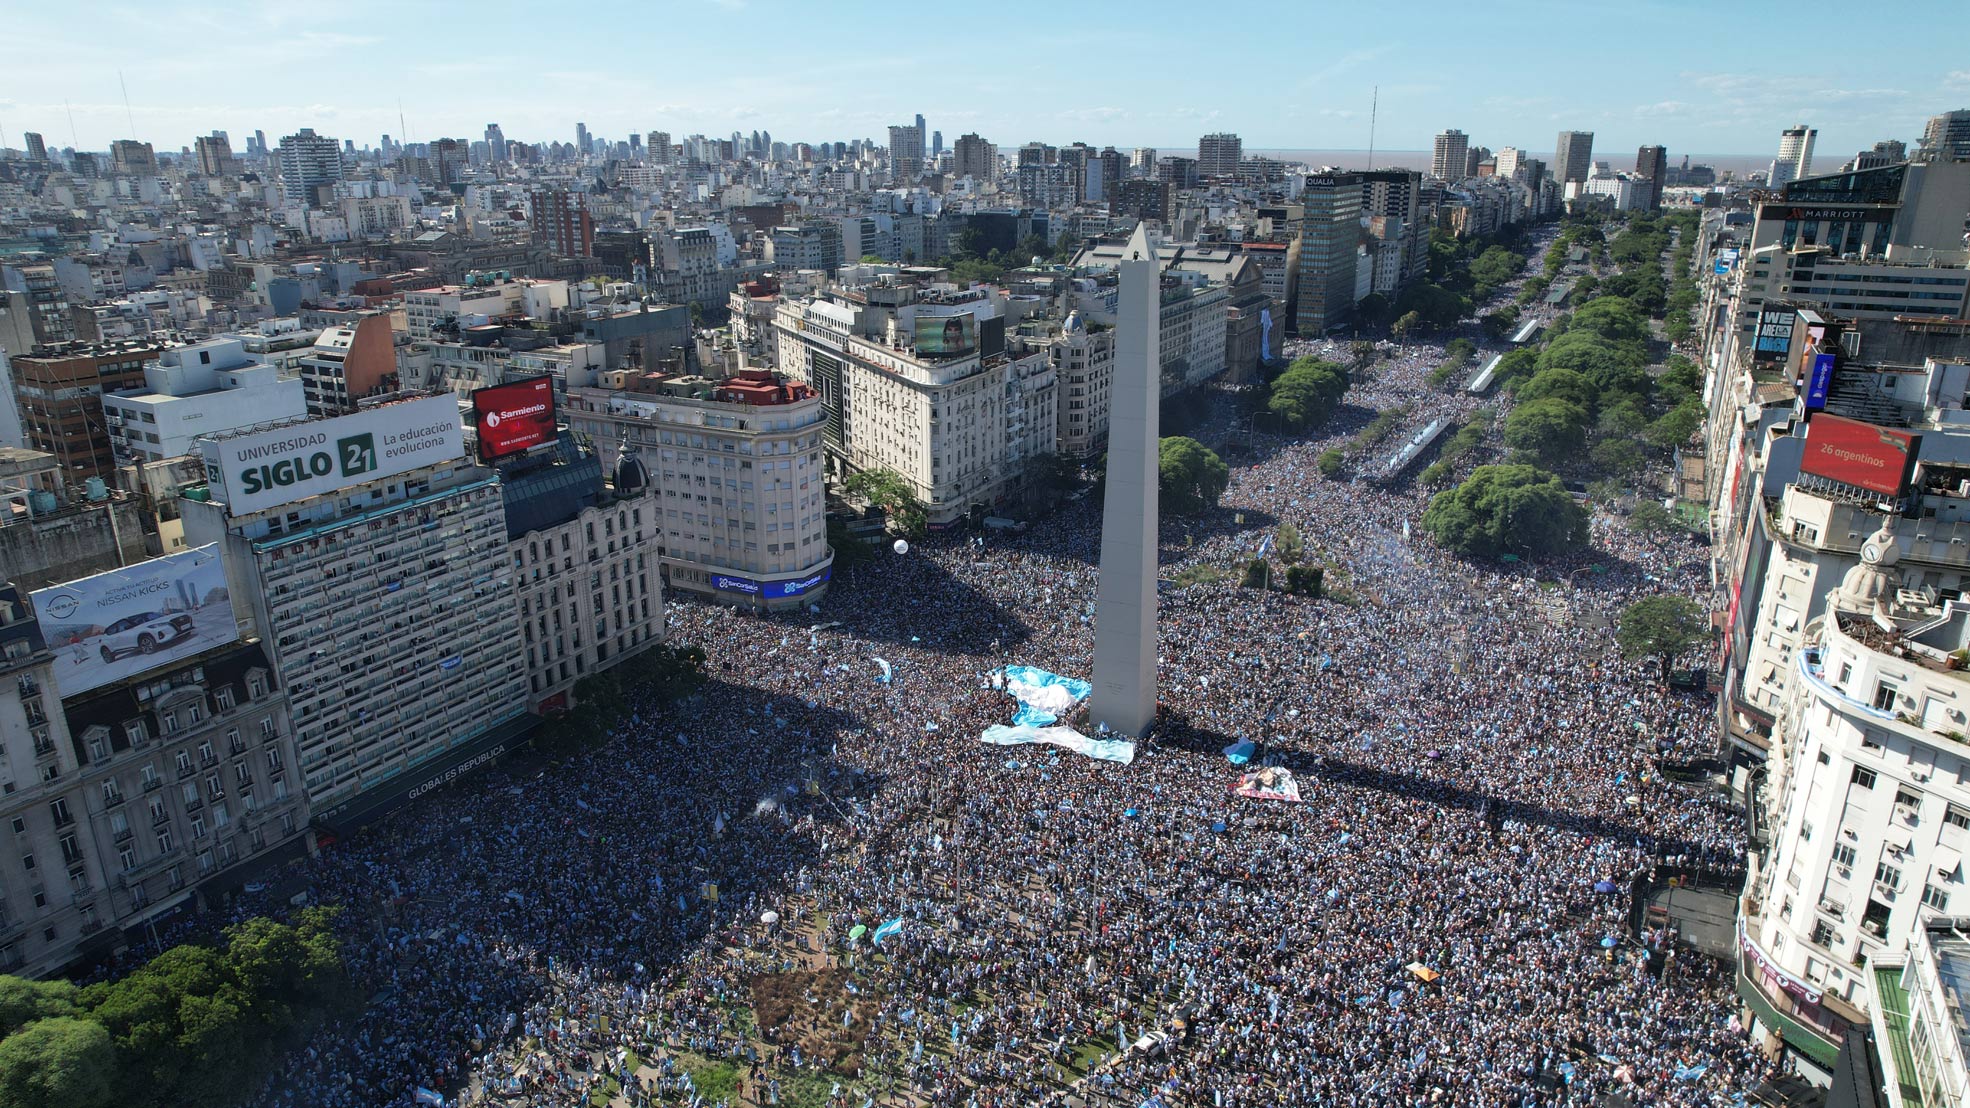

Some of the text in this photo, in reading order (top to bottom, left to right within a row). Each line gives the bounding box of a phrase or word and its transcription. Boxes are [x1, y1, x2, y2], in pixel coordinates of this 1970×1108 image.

[1307, 178, 1335, 186] QUALIA
[1805, 210, 1865, 218] MARRIOTT
[1764, 311, 1796, 324] WE
[1760, 323, 1777, 337] ARE
[501, 403, 546, 420] Sarmiento
[383, 421, 453, 446] La educación
[237, 432, 327, 462] UNIVERSIDAD
[346, 443, 373, 472] 21
[385, 436, 445, 459] evoluciona
[1820, 443, 1885, 468] 26 argentinos
[241, 451, 333, 494] SIGLO
[97, 580, 170, 608] NISSAN KICKS
[46, 601, 79, 613] NISSAN
[458, 744, 506, 775] REPUBLICA
